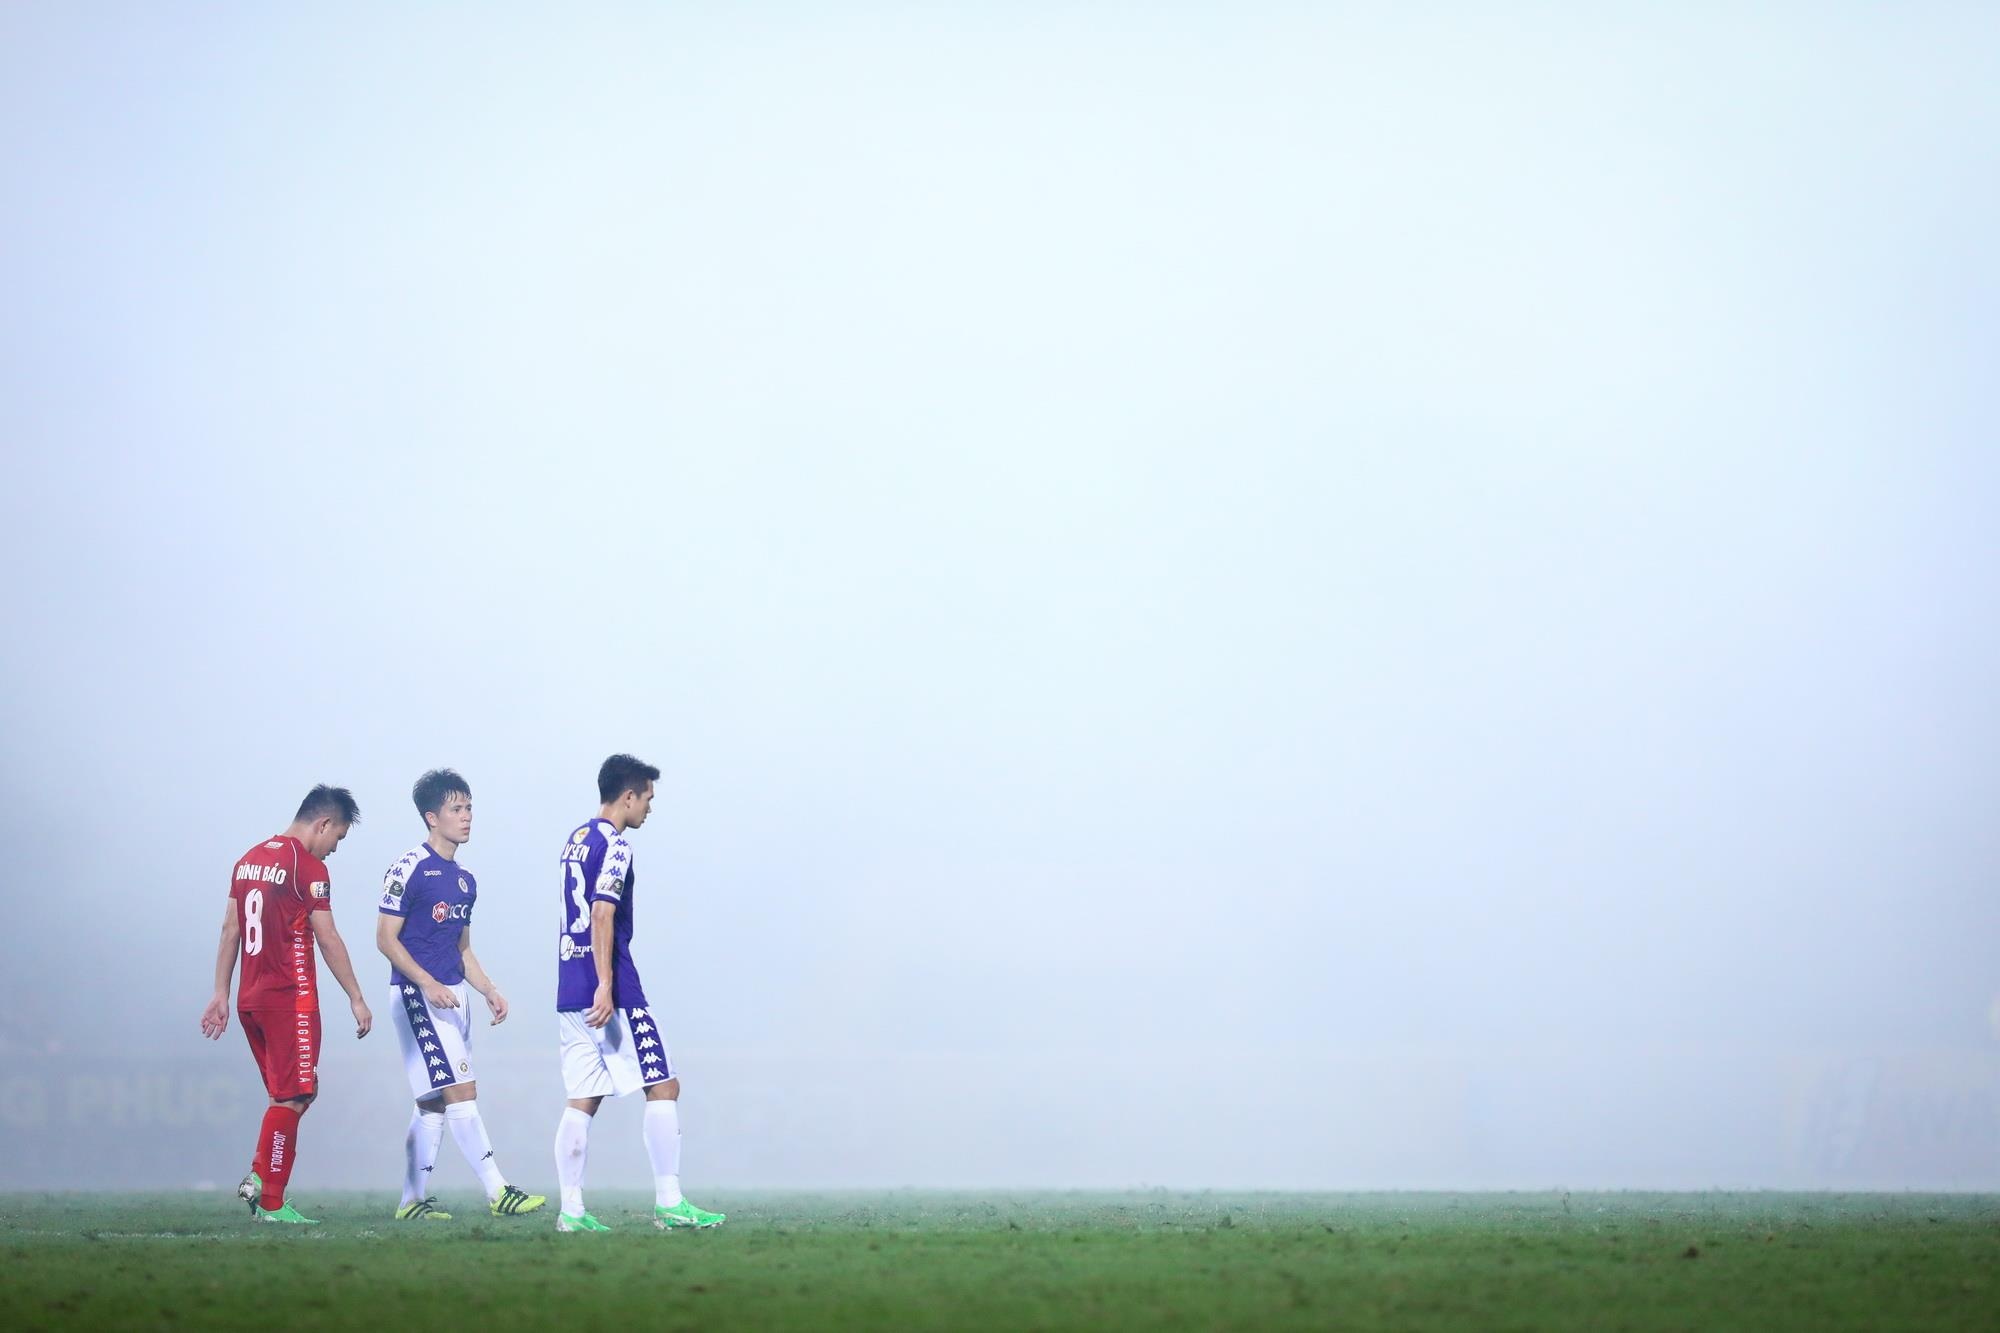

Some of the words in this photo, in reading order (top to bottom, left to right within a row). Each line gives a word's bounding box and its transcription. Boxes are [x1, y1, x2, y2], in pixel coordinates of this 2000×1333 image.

[262, 863, 286, 884] BẢO
[245, 889, 263, 956] 8
[298, 1013, 311, 1083] JOGARBOLA
[270, 1130, 286, 1172] JOGARBOLA
